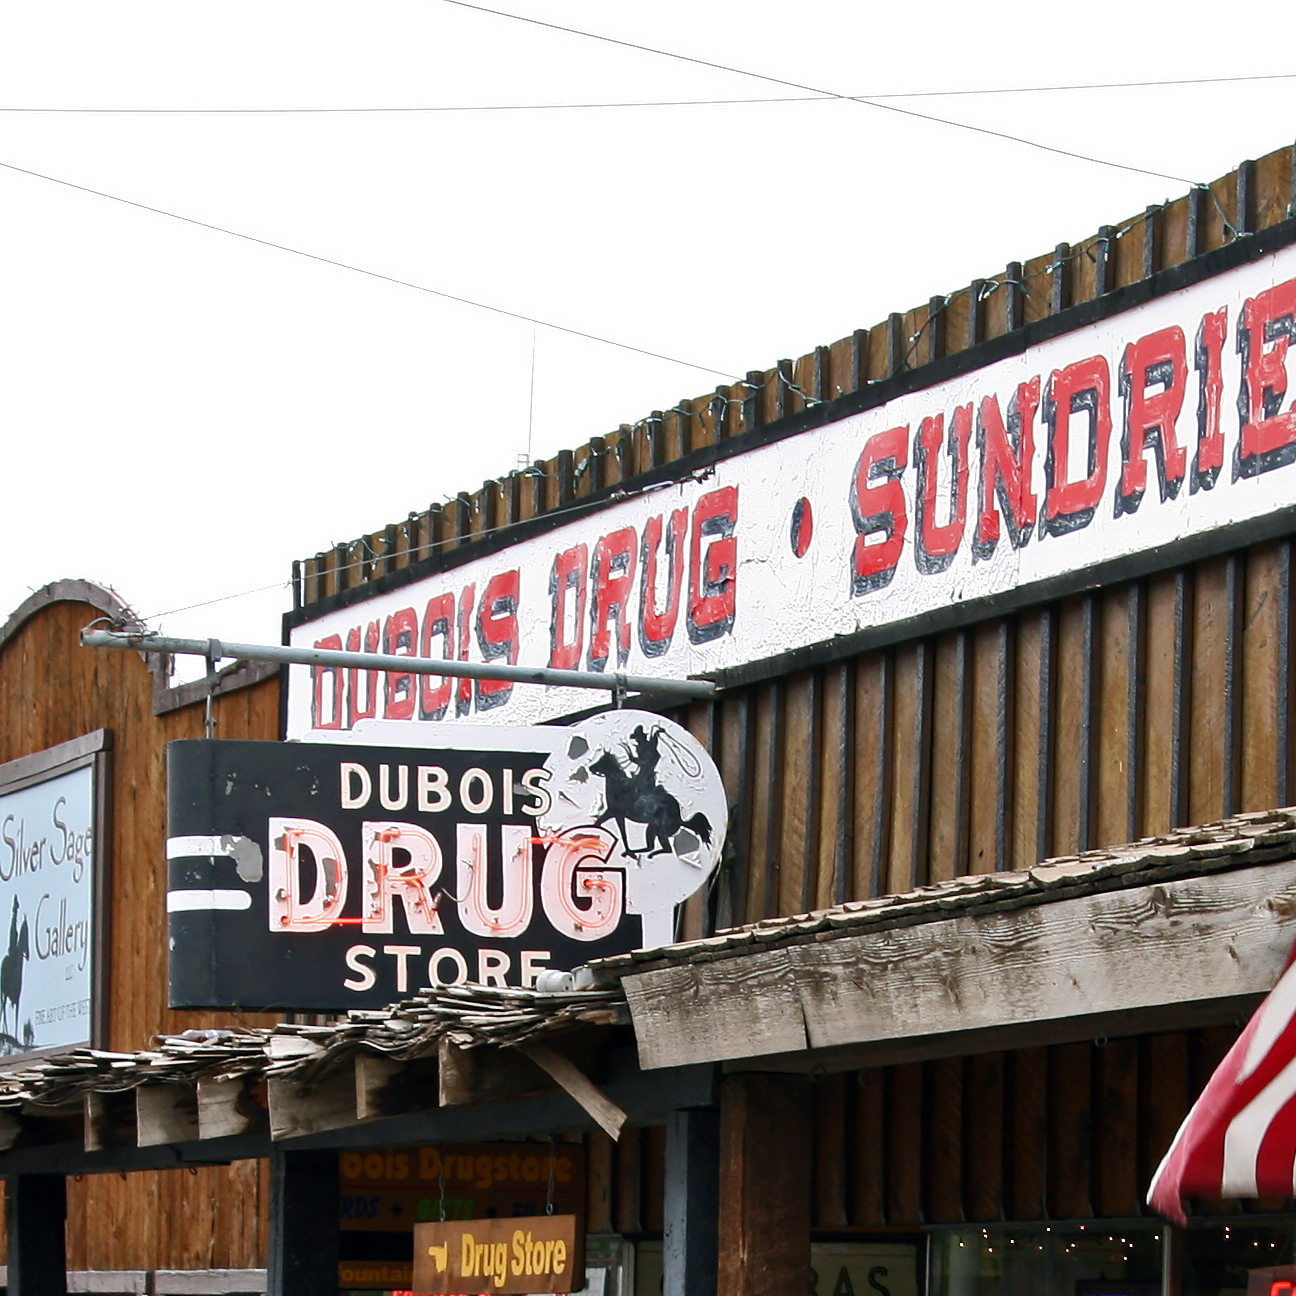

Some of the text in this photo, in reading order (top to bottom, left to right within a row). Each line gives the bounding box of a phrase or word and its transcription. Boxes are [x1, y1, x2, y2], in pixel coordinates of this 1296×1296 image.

[311, 569, 521, 731] DUBOIS
[548, 484, 740, 687] DRUG
[340, 762, 553, 817] DUBOIS
[50, 796, 94, 884] Sage
[268, 816, 626, 942] DRUG
[35, 893, 88, 972] Gallery
[340, 1146, 574, 1190] bois Drugstore
[340, 1197, 381, 1218] RDS
[341, 1265, 414, 1284] ountai
[460, 1229, 568, 1288] Drug Store
